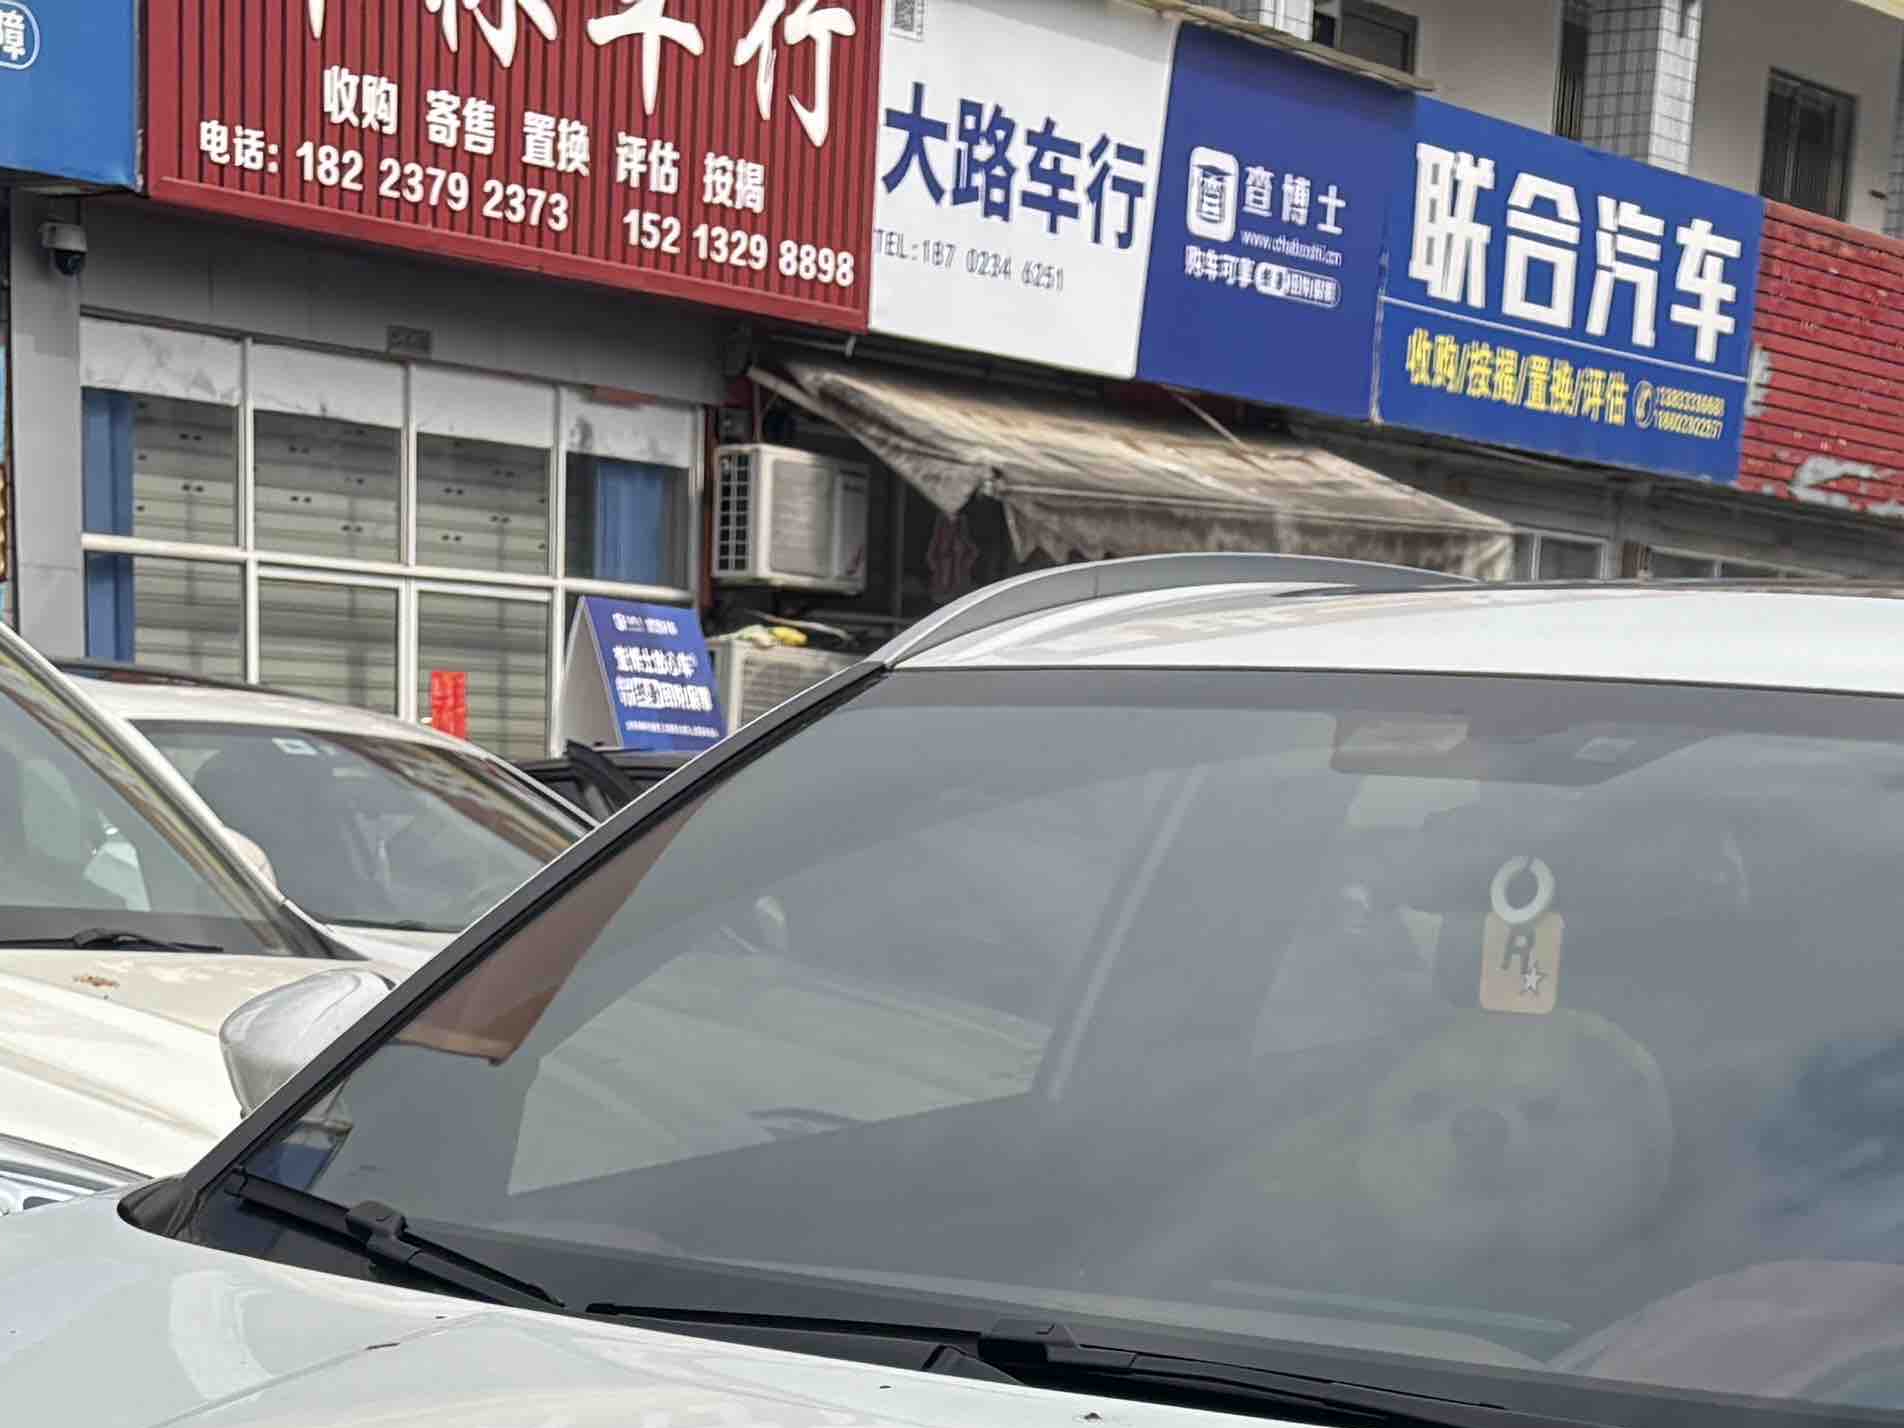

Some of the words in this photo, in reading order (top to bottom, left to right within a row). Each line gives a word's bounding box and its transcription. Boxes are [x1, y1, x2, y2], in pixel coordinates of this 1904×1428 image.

[304, 0, 857, 147] 车行
[323, 64, 398, 135] 收购
[426, 89, 496, 156] 寄售
[520, 110, 590, 177] 置换
[615, 131, 681, 195] 评估
[702, 151, 766, 214] 按揭
[295, 140, 365, 192] 182
[378, 157, 470, 212] 2379
[481, 178, 569, 232] 2373
[622, 208, 681, 254] 152
[692, 223, 769, 271] 1329
[778, 239, 855, 287] 8898
[883, 82, 1148, 252] 大路车行
[1242, 165, 1347, 235] 查博士
[1407, 141, 1741, 364] 联合汽车
